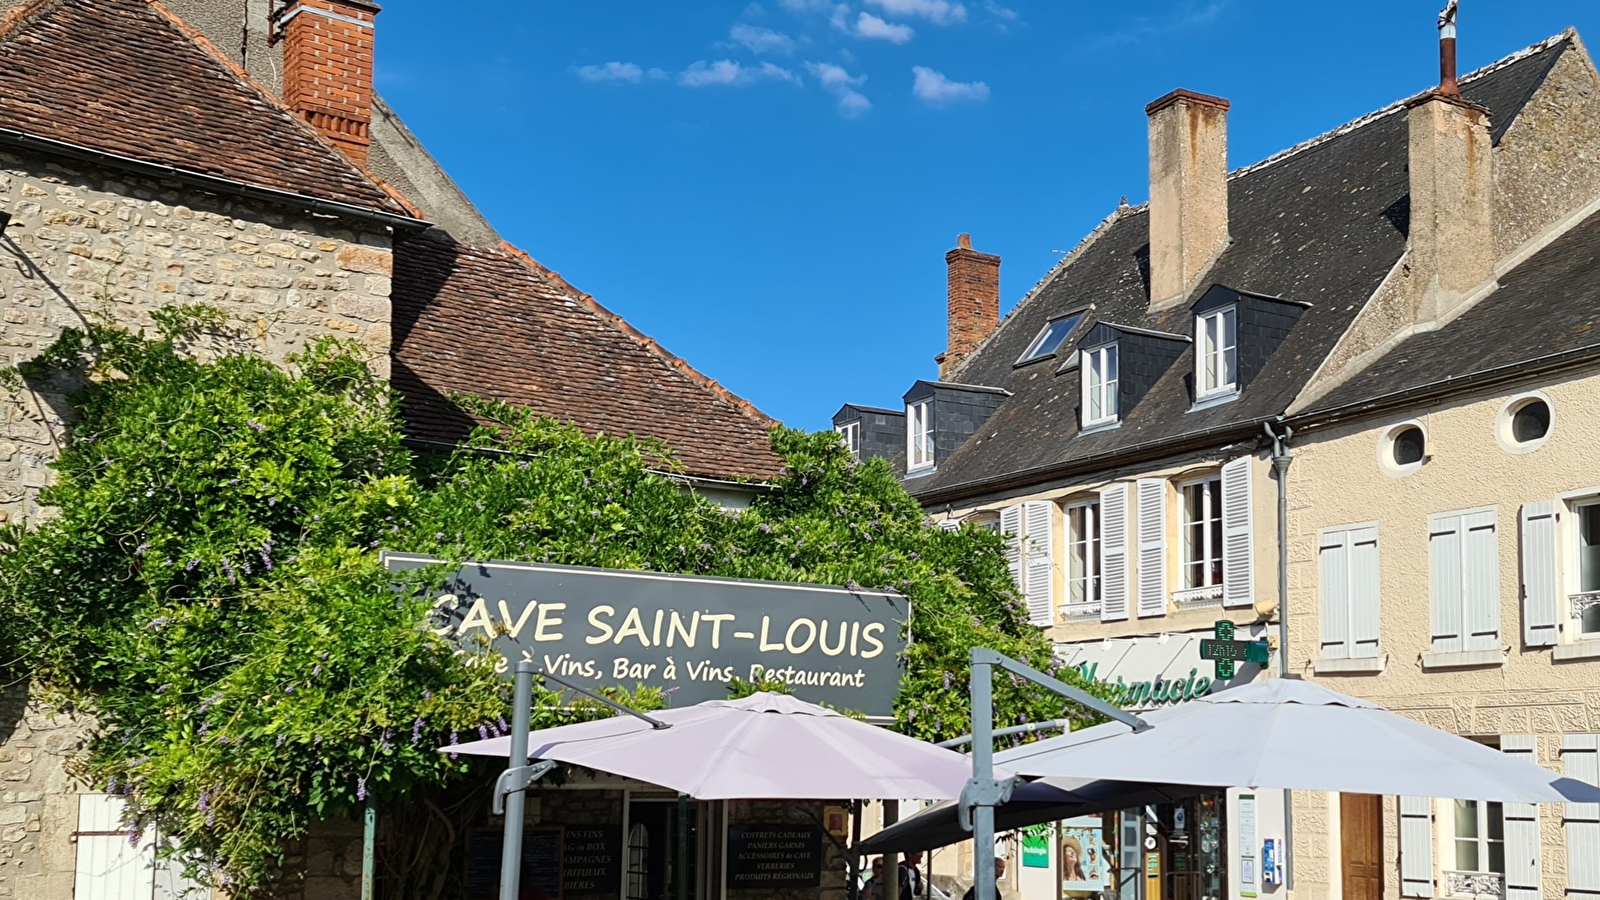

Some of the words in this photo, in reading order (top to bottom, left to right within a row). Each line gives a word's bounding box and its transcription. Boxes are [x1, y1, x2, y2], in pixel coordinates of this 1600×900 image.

[425, 594, 566, 641] CAVE
[585, 605, 885, 659] SAINT-LOUIS
[543, 653, 602, 680] Vins,
[613, 657, 656, 679] Bar
[663, 656, 676, 680] à
[749, 664, 865, 688] Restaurant
[565, 830, 582, 839] INS
[583, 830, 604, 839] FINS
[741, 831, 777, 839] COFFRETS
[778, 831, 811, 839] CADEAUX
[586, 842, 607, 851] BOX
[747, 842, 777, 850] PANIERS
[564, 855, 612, 864] AMPAGNES
[737, 852, 784, 860] ACCESSOIRES
[785, 852, 793, 860] de
[757, 862, 795, 870] VERRERIES
[563, 867, 607, 877] IRITUEUX
[735, 873, 771, 881] PRODUITS
[772, 871, 815, 880] RÉGIONAUX
